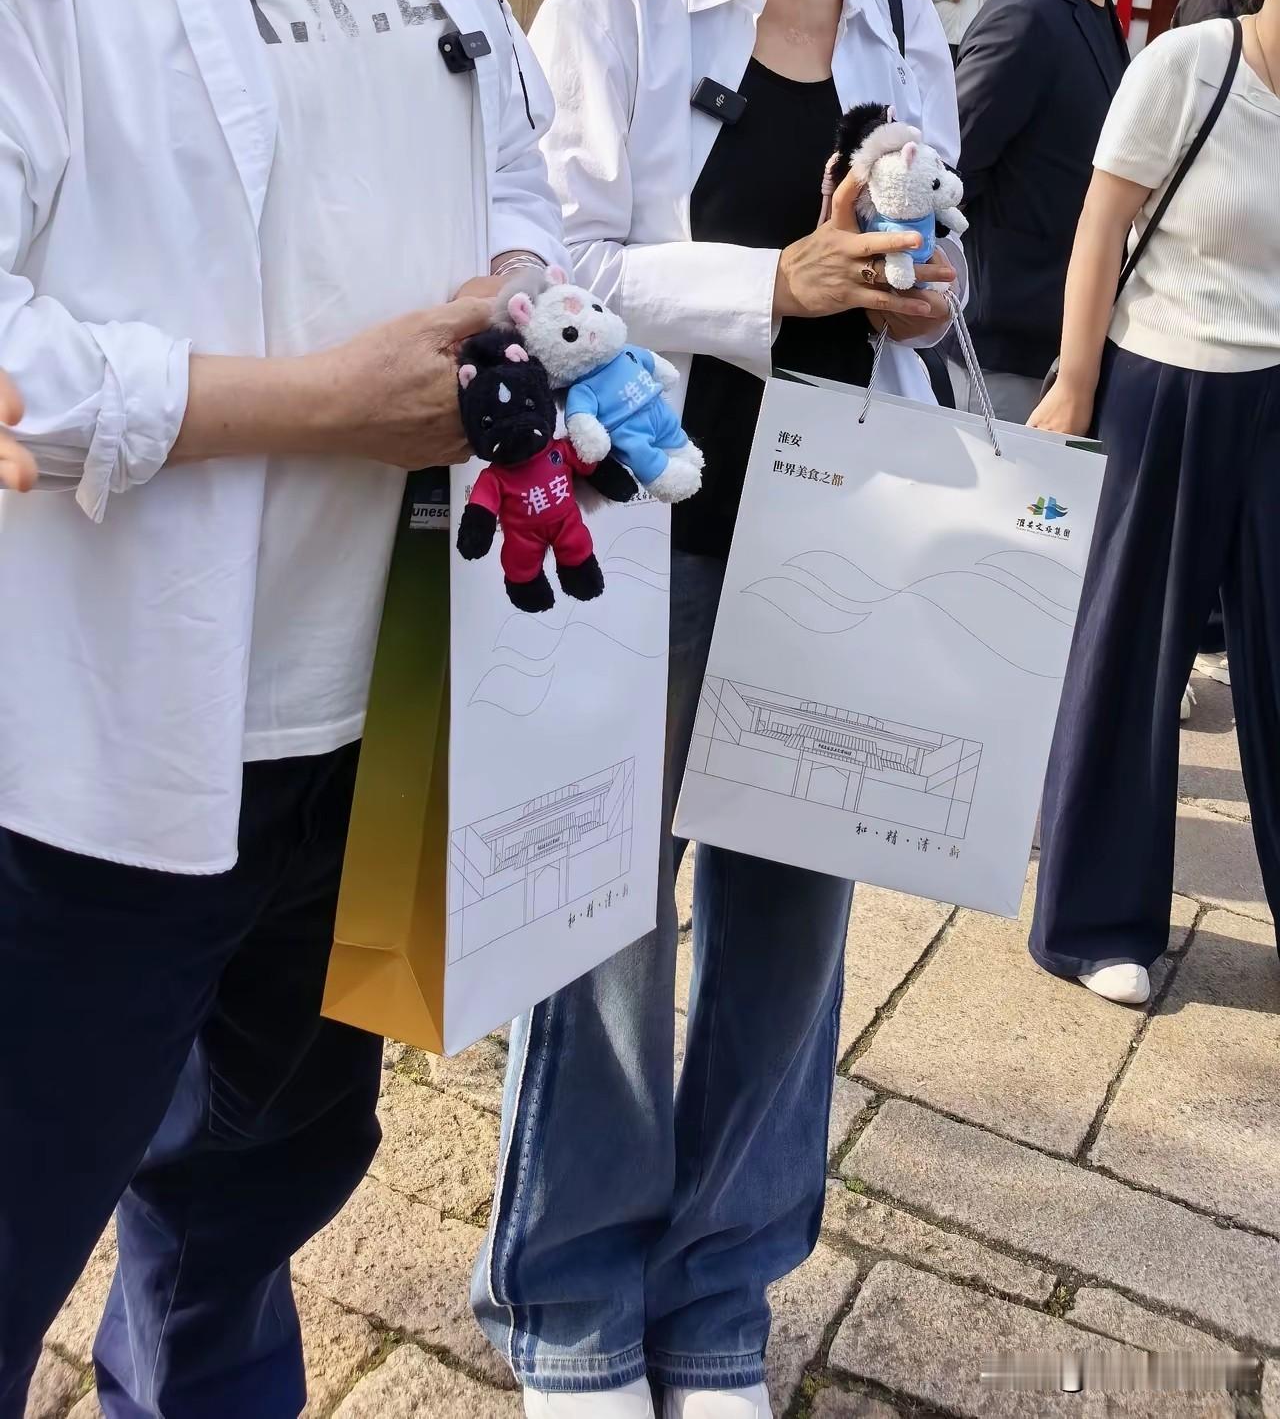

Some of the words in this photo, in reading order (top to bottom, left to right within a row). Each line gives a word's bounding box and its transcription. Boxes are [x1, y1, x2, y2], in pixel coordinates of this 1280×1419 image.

[777, 430, 802, 447] 淮安
[773, 460, 844, 486] 世界美食之都
[521, 474, 570, 516] 淮安
[411, 506, 450, 518] unesc
